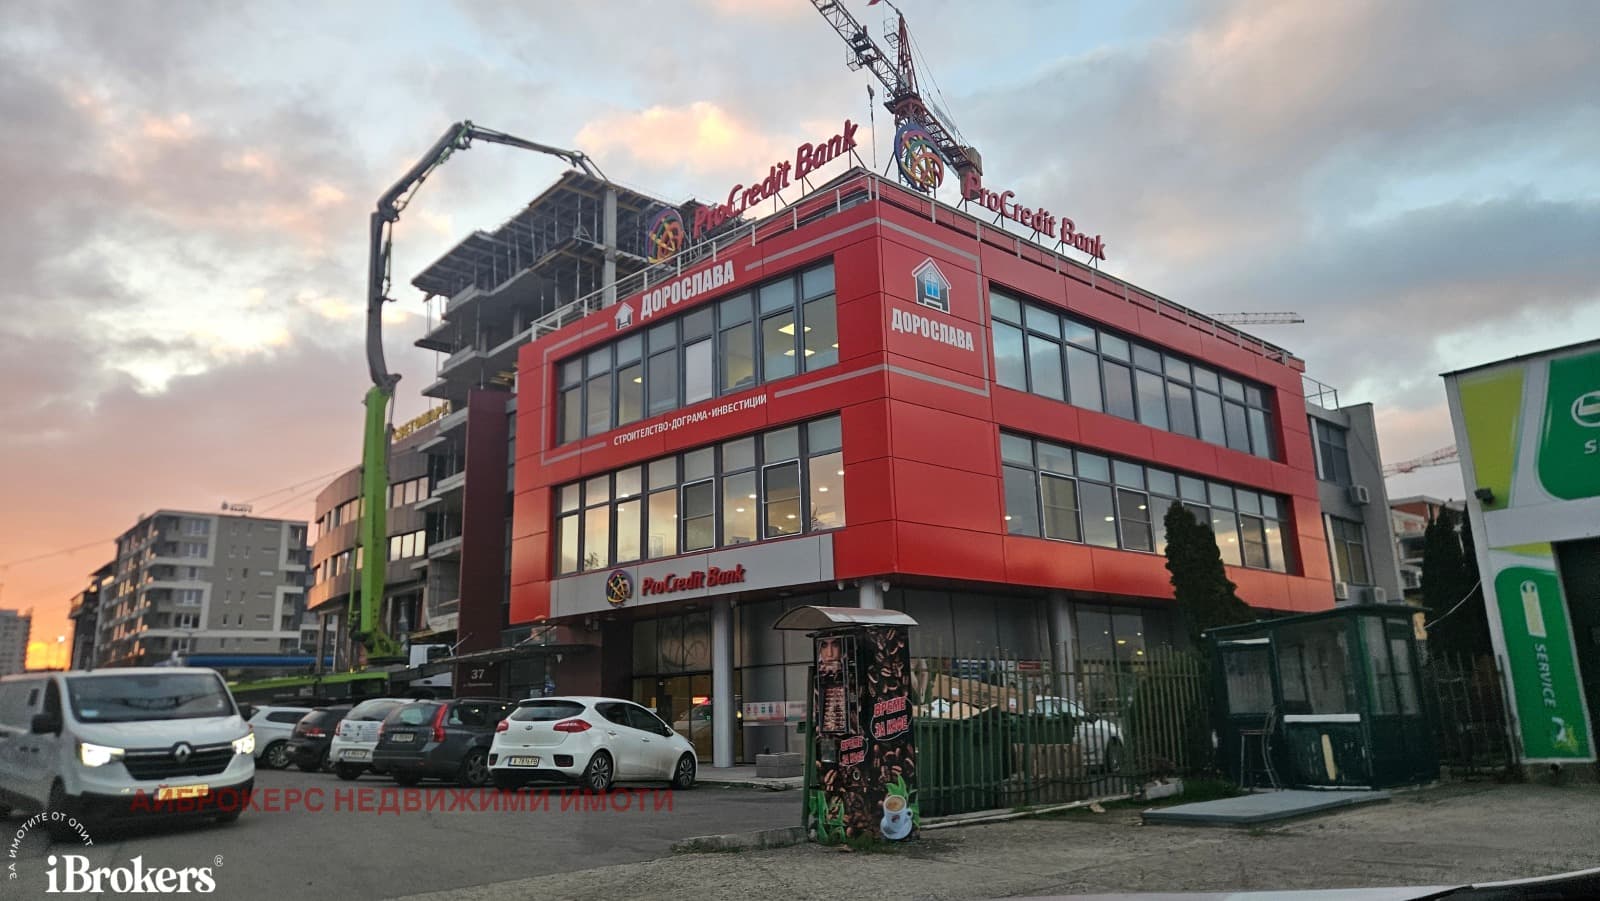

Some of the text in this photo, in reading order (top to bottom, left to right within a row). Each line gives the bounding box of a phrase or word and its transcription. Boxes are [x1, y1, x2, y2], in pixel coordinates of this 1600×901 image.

[694, 119, 858, 238] ProCredit Bank
[963, 171, 1105, 260] ProCredit Bank
[641, 260, 735, 320] ДОРОСЛАВА
[892, 307, 974, 352] ДОРОСЛАВА
[641, 564, 746, 596] ProCredit Bank
[471, 669, 485, 680] 37
[1535, 643, 1556, 708] SERVICE
